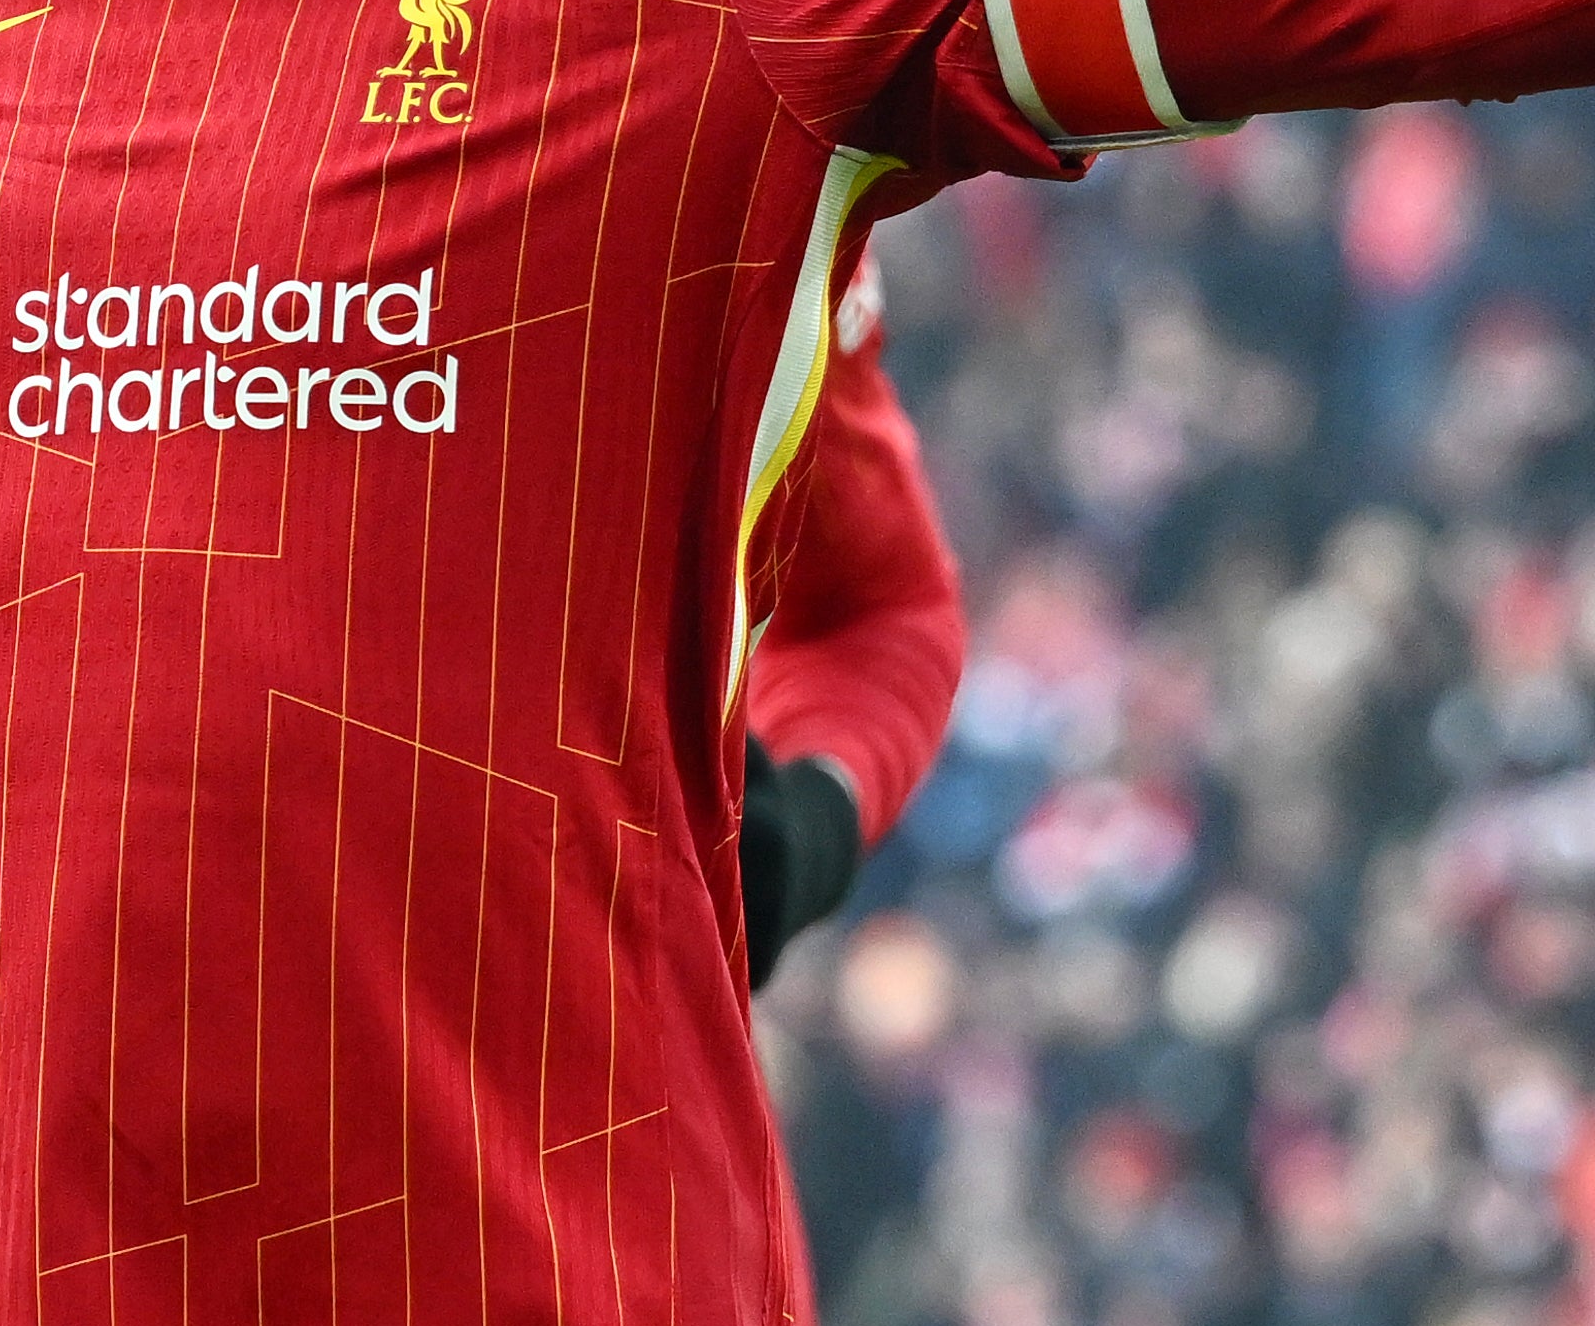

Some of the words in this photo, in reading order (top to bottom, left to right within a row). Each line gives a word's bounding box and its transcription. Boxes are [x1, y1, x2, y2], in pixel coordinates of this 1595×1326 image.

[359, 81, 473, 124] L.F.C.
[12, 263, 434, 353] standard
[8, 350, 459, 438] chartered
